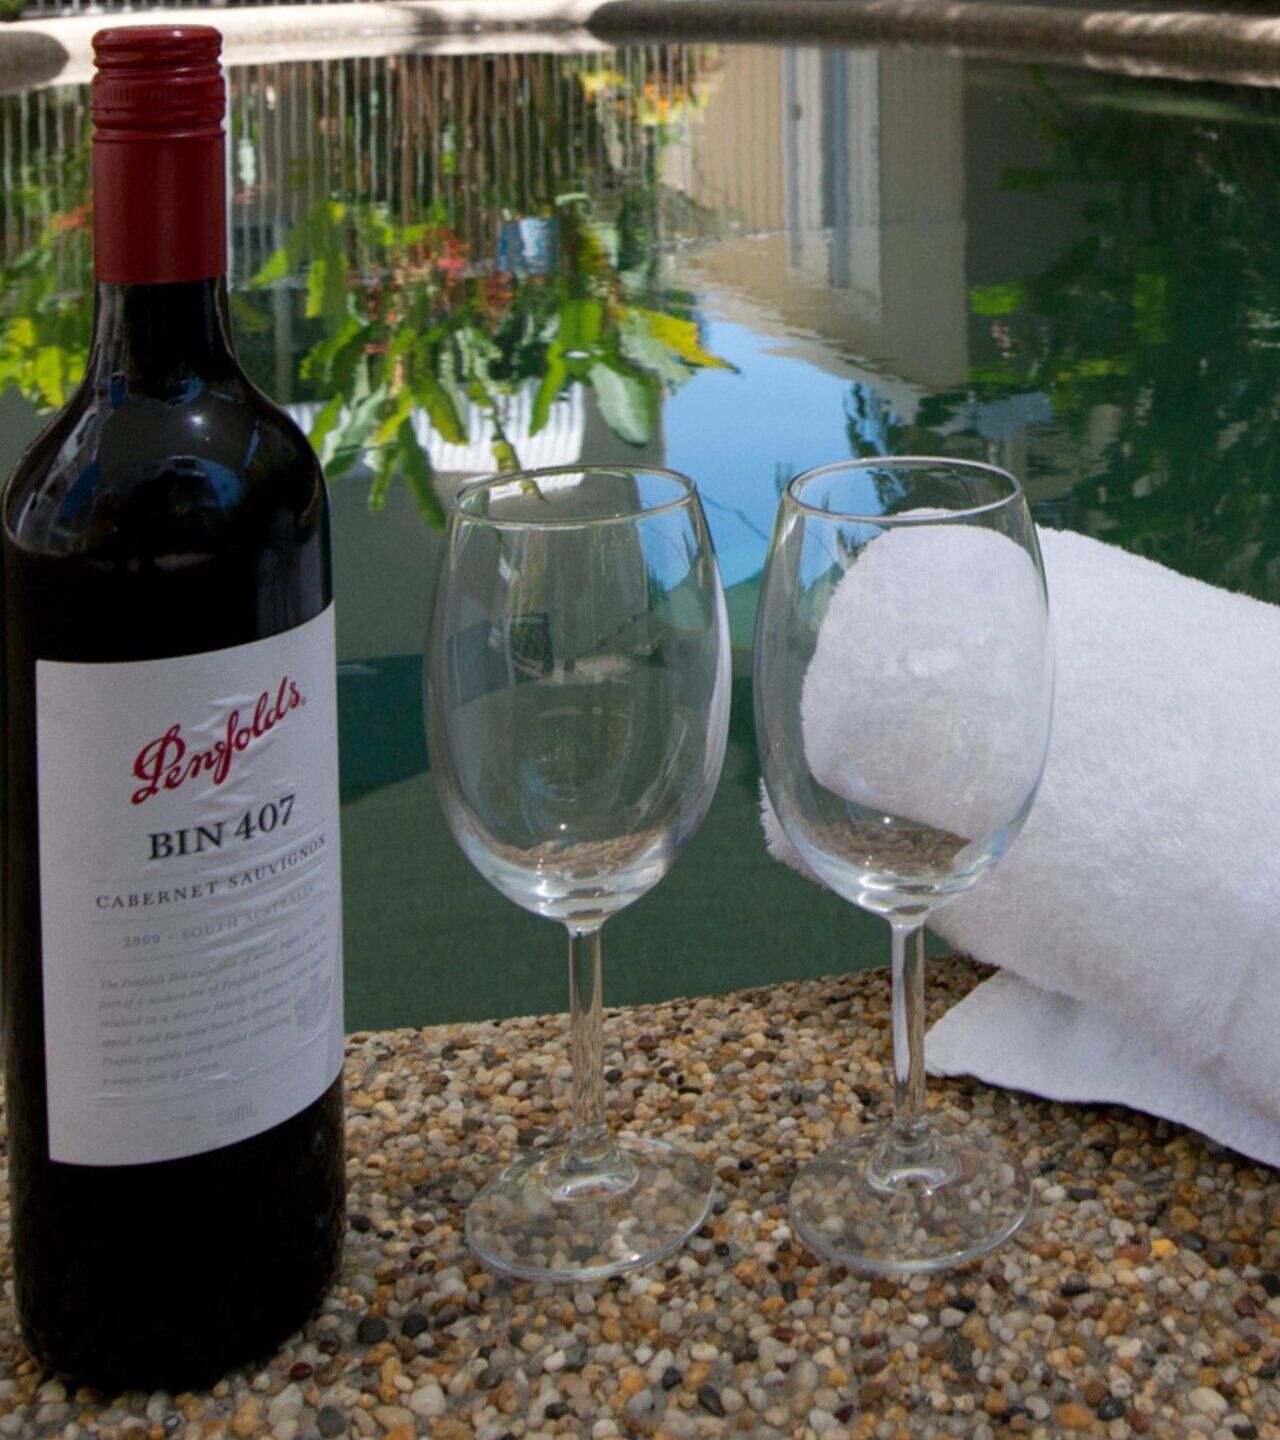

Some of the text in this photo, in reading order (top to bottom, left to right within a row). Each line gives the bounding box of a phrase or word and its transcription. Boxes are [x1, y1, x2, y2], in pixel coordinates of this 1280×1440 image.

[131, 676, 301, 805] Penfolds
[148, 793, 297, 860] BIN 407
[96, 832, 327, 909] CABERNET SAUVIGNON
[182, 918, 239, 940] SOUTH
